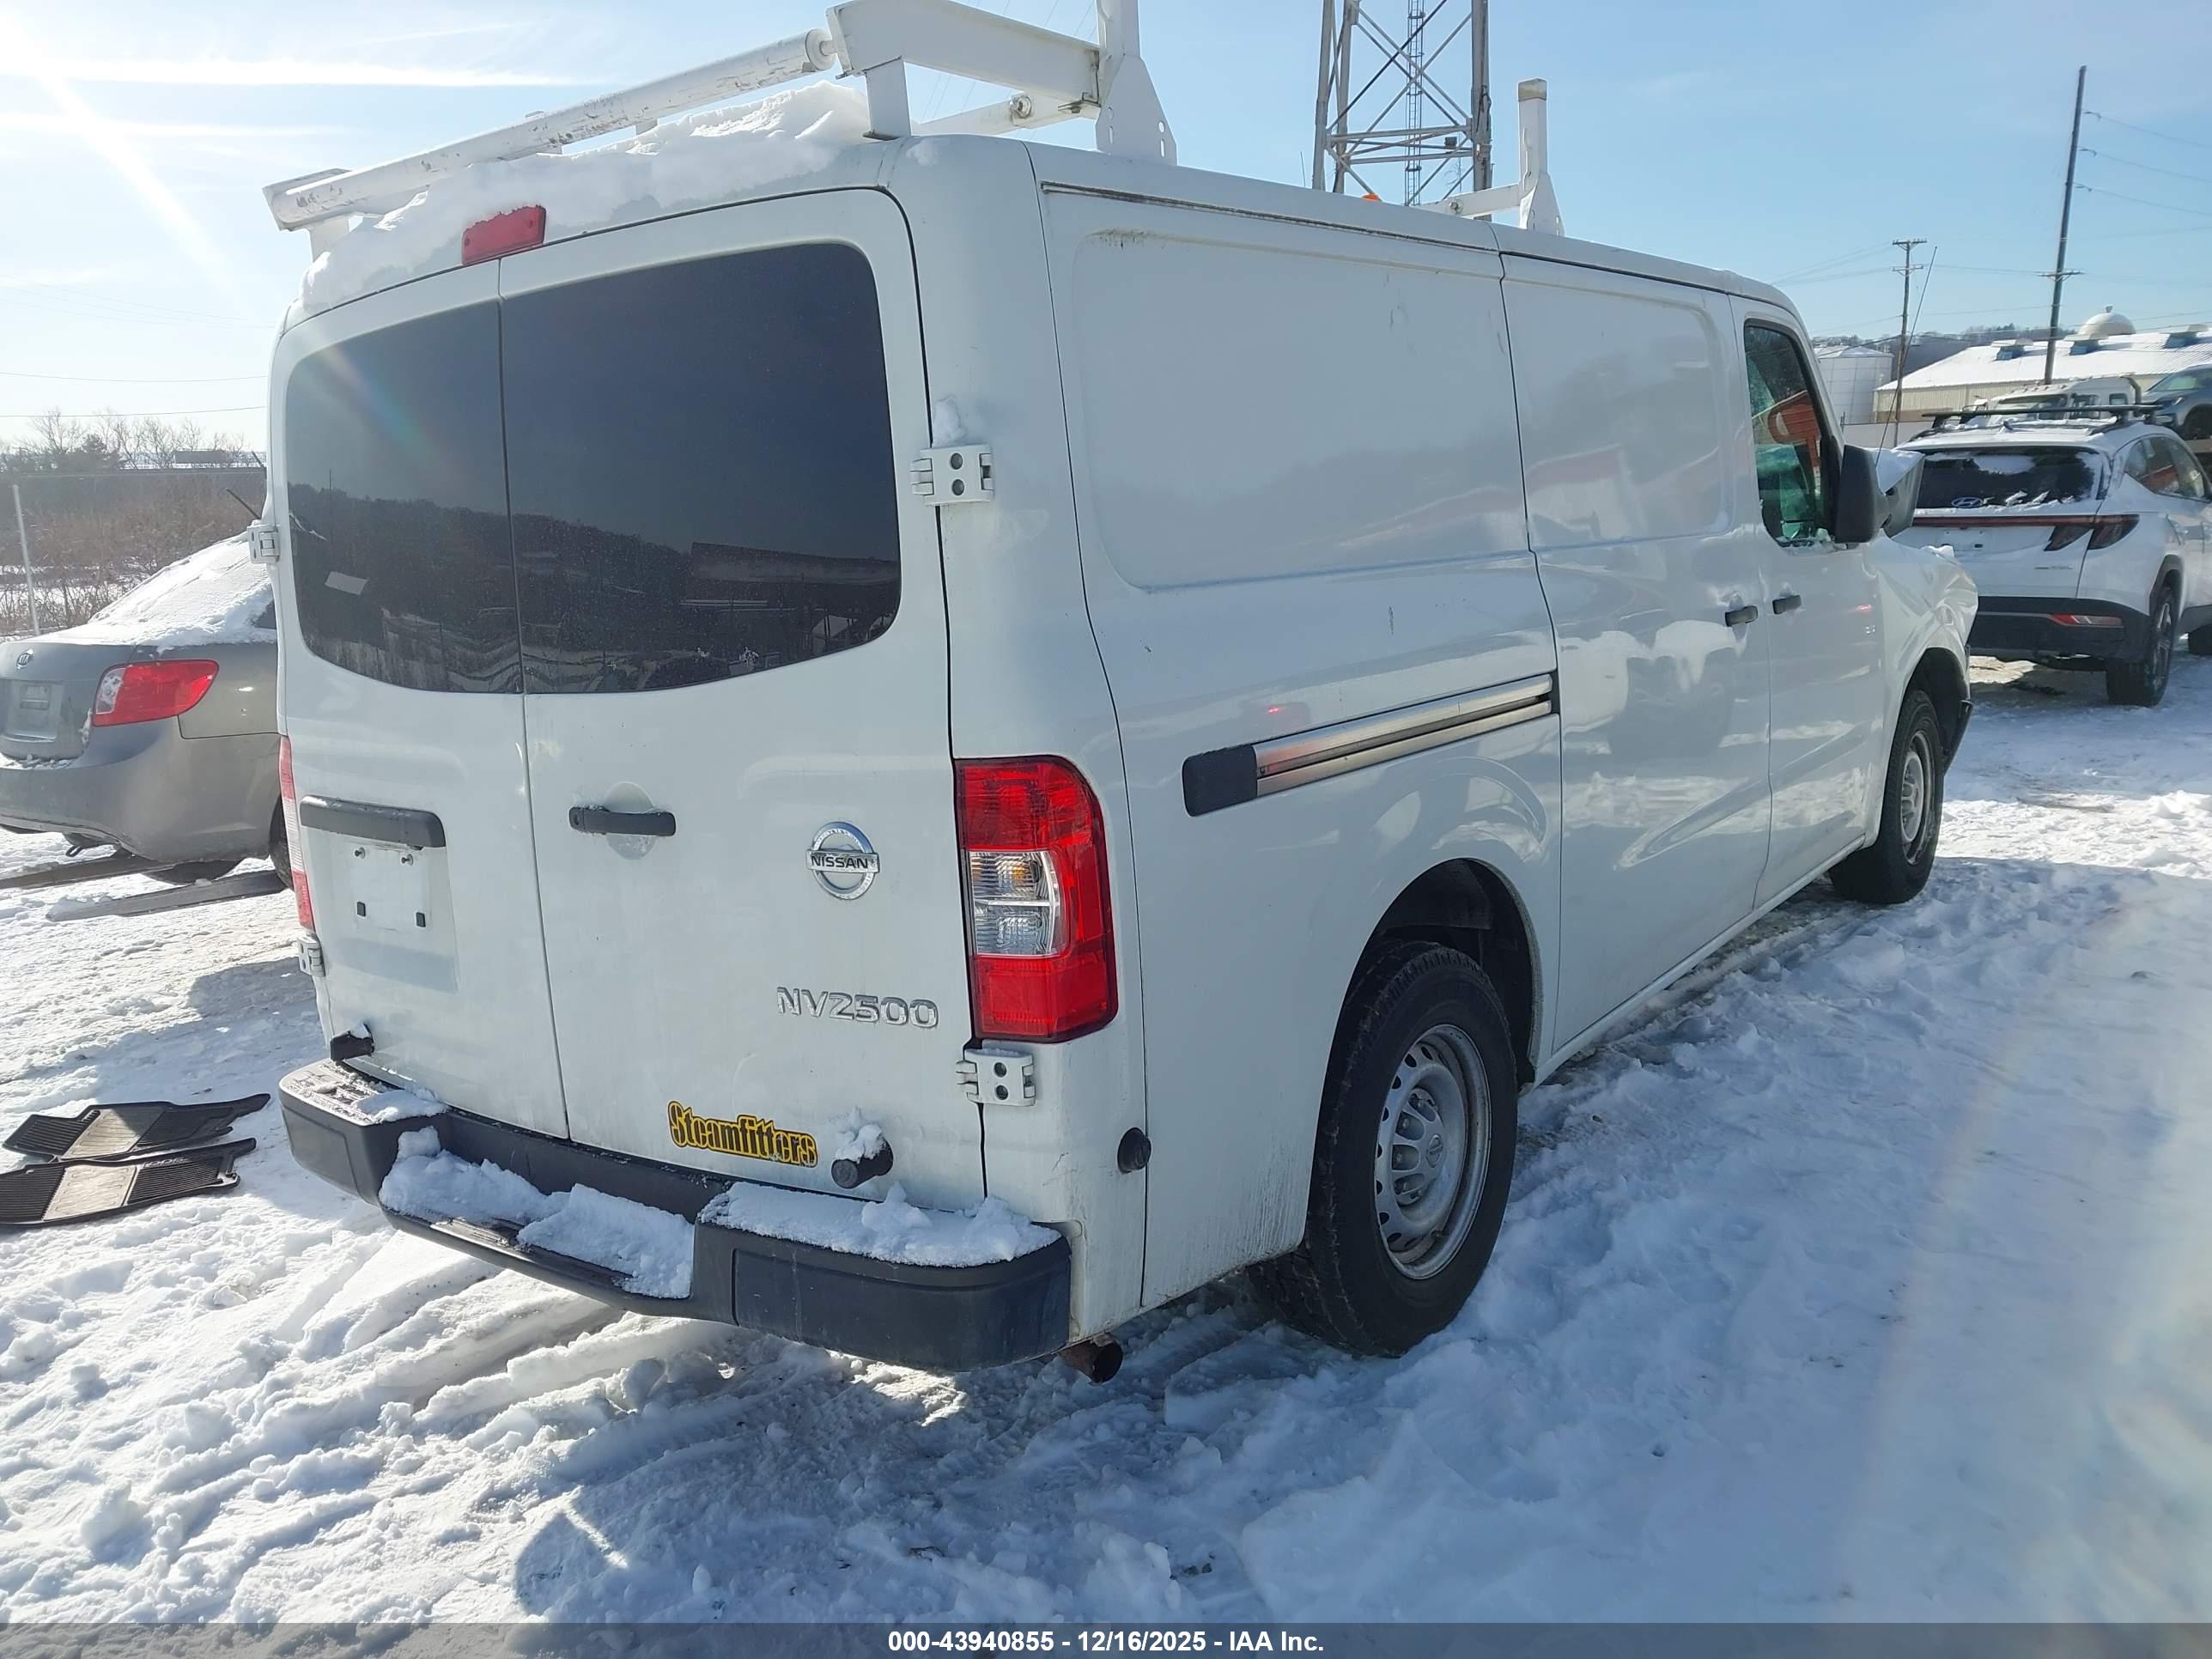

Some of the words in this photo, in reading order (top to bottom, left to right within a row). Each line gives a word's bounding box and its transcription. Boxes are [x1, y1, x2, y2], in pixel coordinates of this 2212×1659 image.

[811, 855, 868, 869] NISSAN
[776, 986, 939, 1029] NV2500
[667, 1101, 817, 1168] Steamfitters
